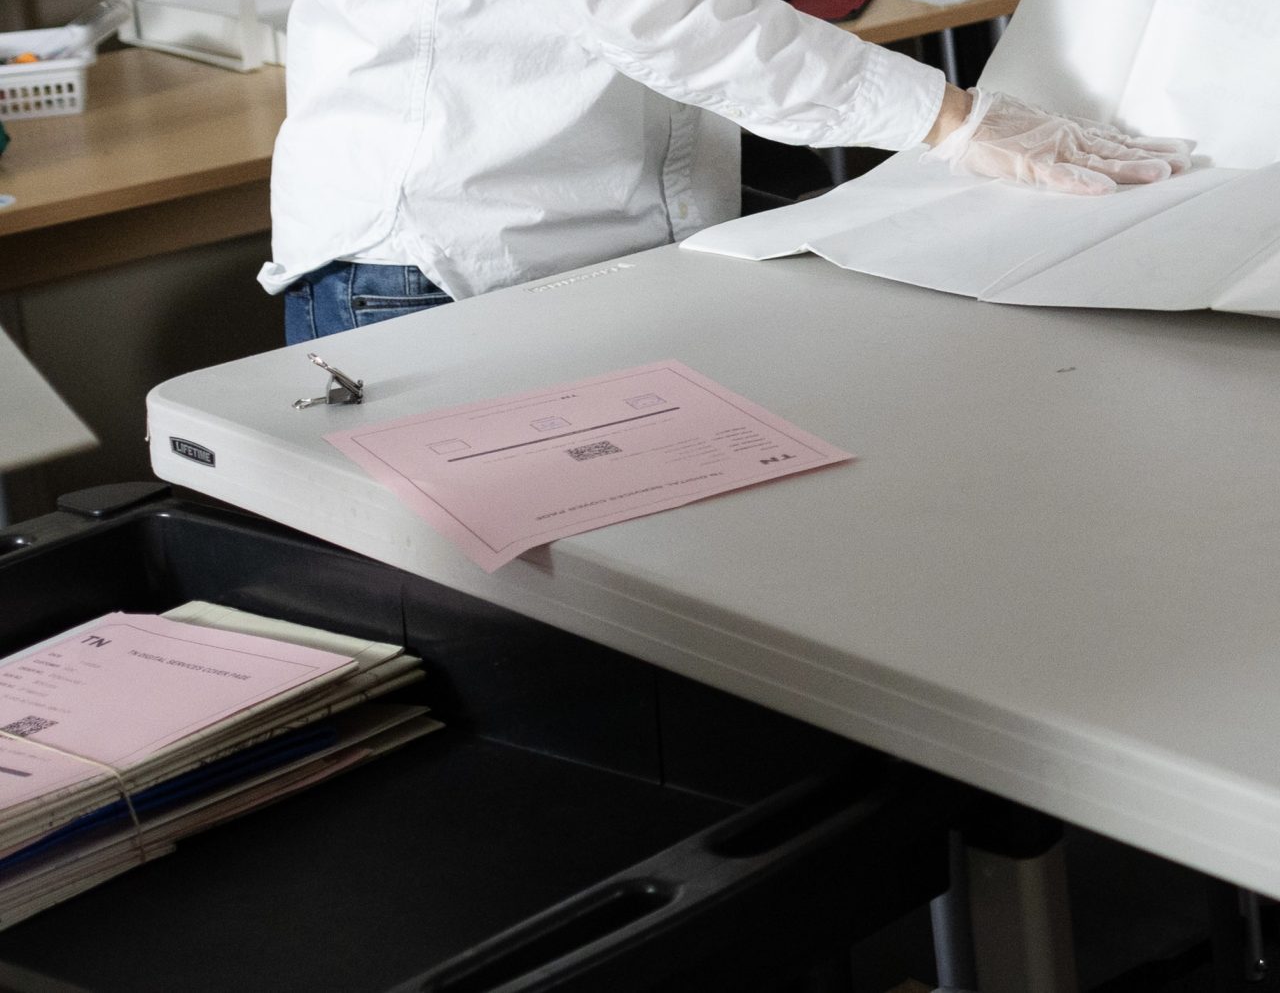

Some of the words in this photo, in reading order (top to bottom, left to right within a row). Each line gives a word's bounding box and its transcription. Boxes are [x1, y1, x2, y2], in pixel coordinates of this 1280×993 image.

[175, 440, 211, 462] LIFETIME
[759, 453, 797, 465] TN
[81, 635, 112, 648] TN
